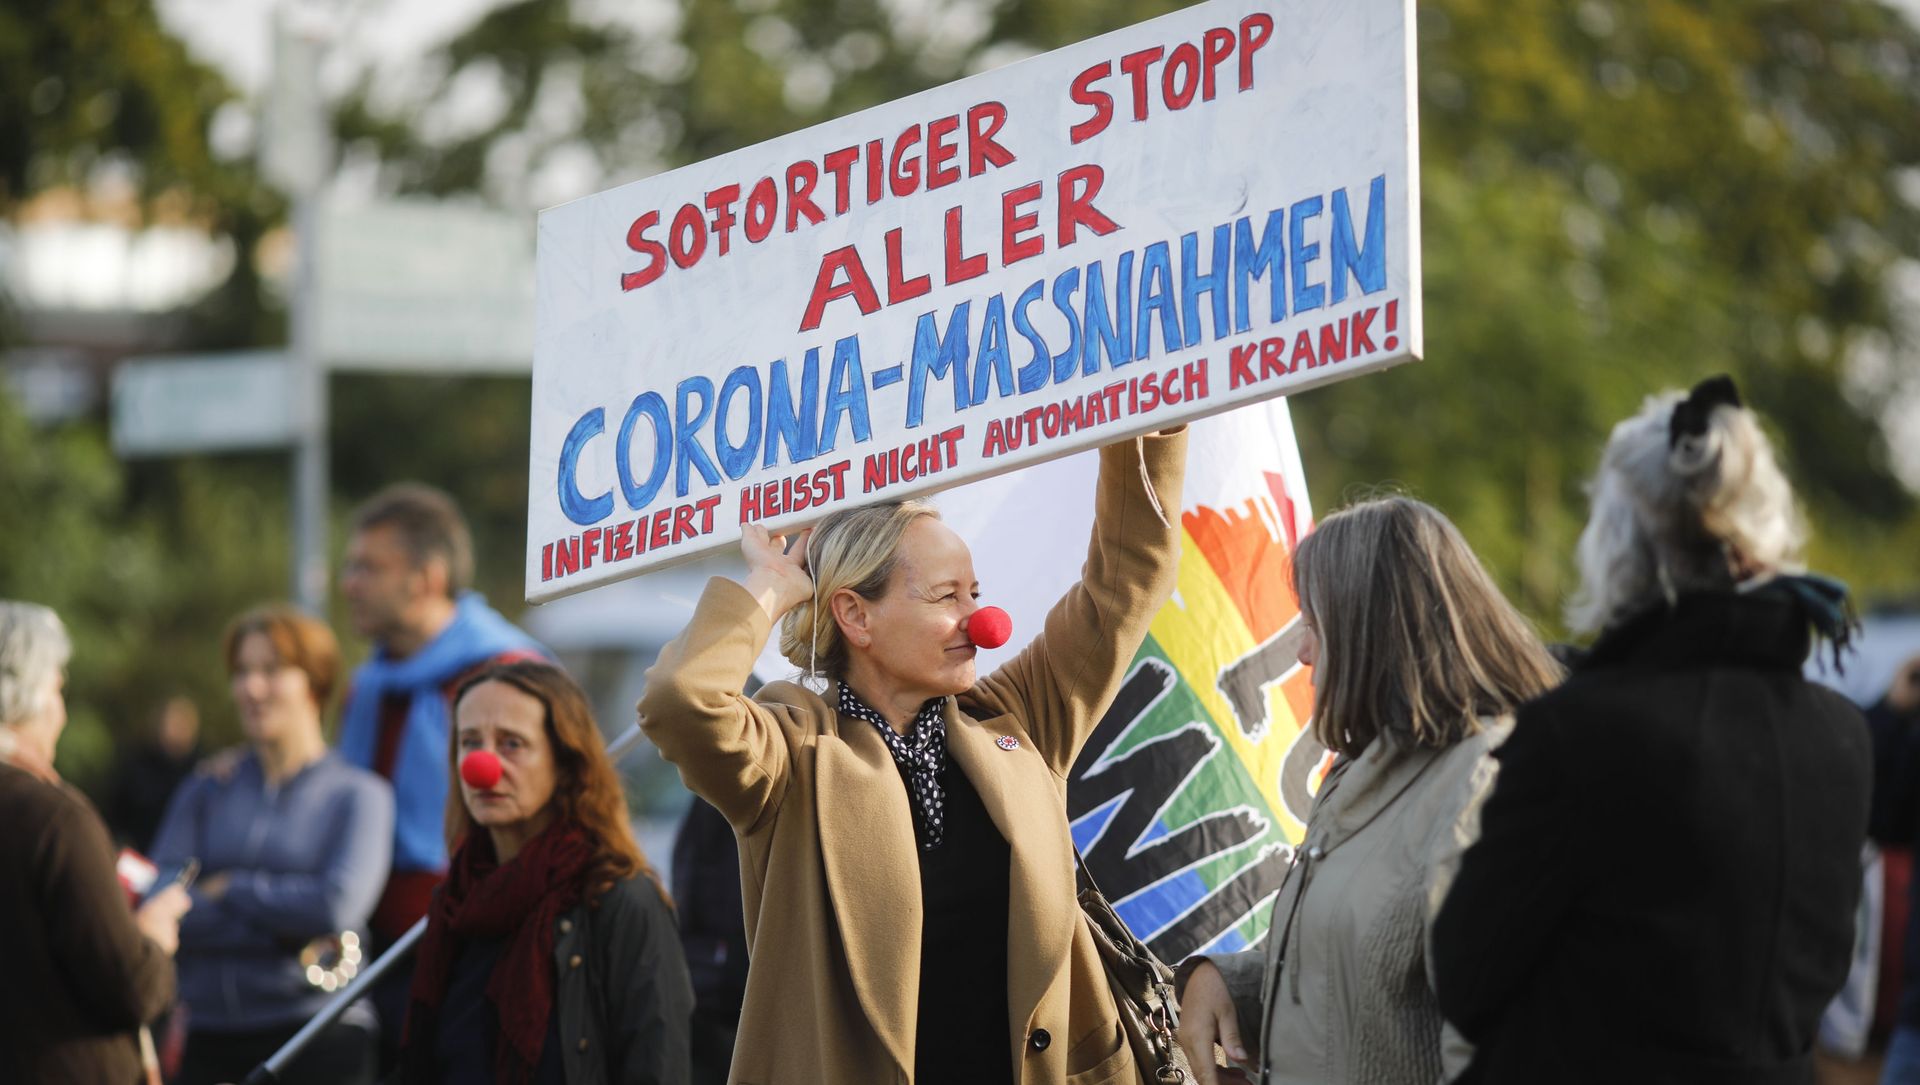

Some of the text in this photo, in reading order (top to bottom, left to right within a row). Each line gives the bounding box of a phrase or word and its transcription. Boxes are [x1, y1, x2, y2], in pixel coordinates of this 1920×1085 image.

[621, 12, 1275, 292] SOFORTIGER STOPP
[798, 163, 1125, 333] ALLER
[541, 298, 1399, 583] INFIZIERT HEISST NICHT AUTOMATISCH KRANK!
[557, 173, 1388, 526] CORONA-MASSNAHMEN
